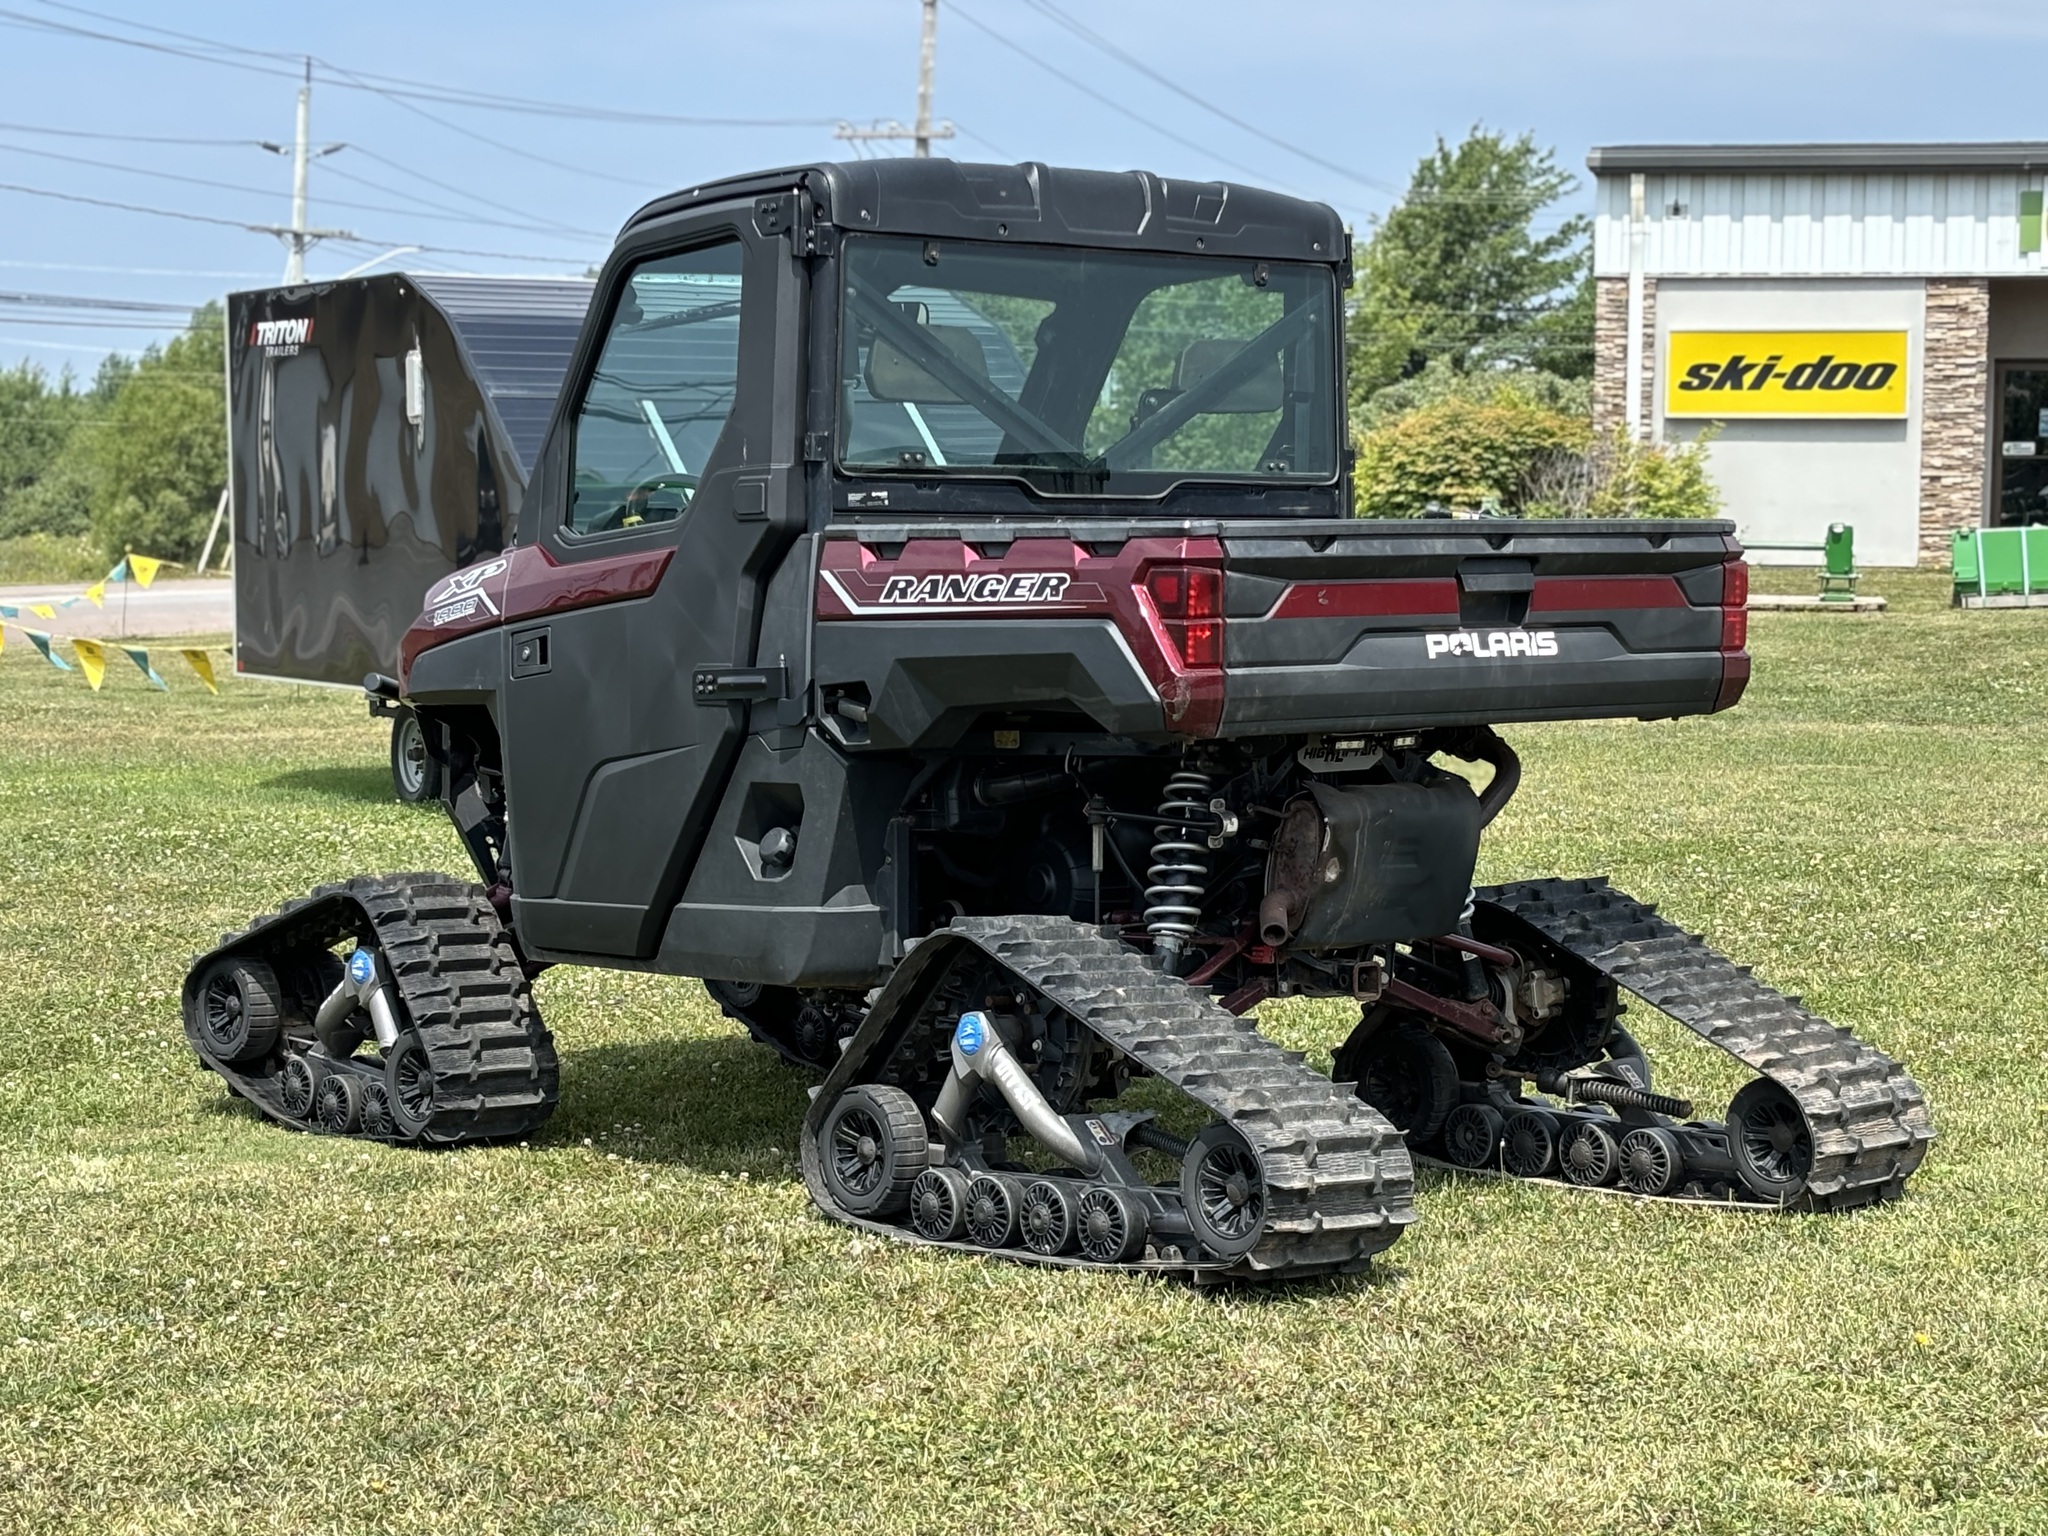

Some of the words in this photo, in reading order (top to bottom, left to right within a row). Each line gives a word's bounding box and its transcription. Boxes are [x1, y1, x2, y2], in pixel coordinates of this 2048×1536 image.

[257, 318, 309, 345] TRITON
[265, 344, 299, 357] TRAILERS
[1678, 355, 1898, 391] ski-doo
[433, 559, 507, 603] XP
[879, 573, 1071, 602] RANGER
[1425, 631, 1558, 659] POLARIS
